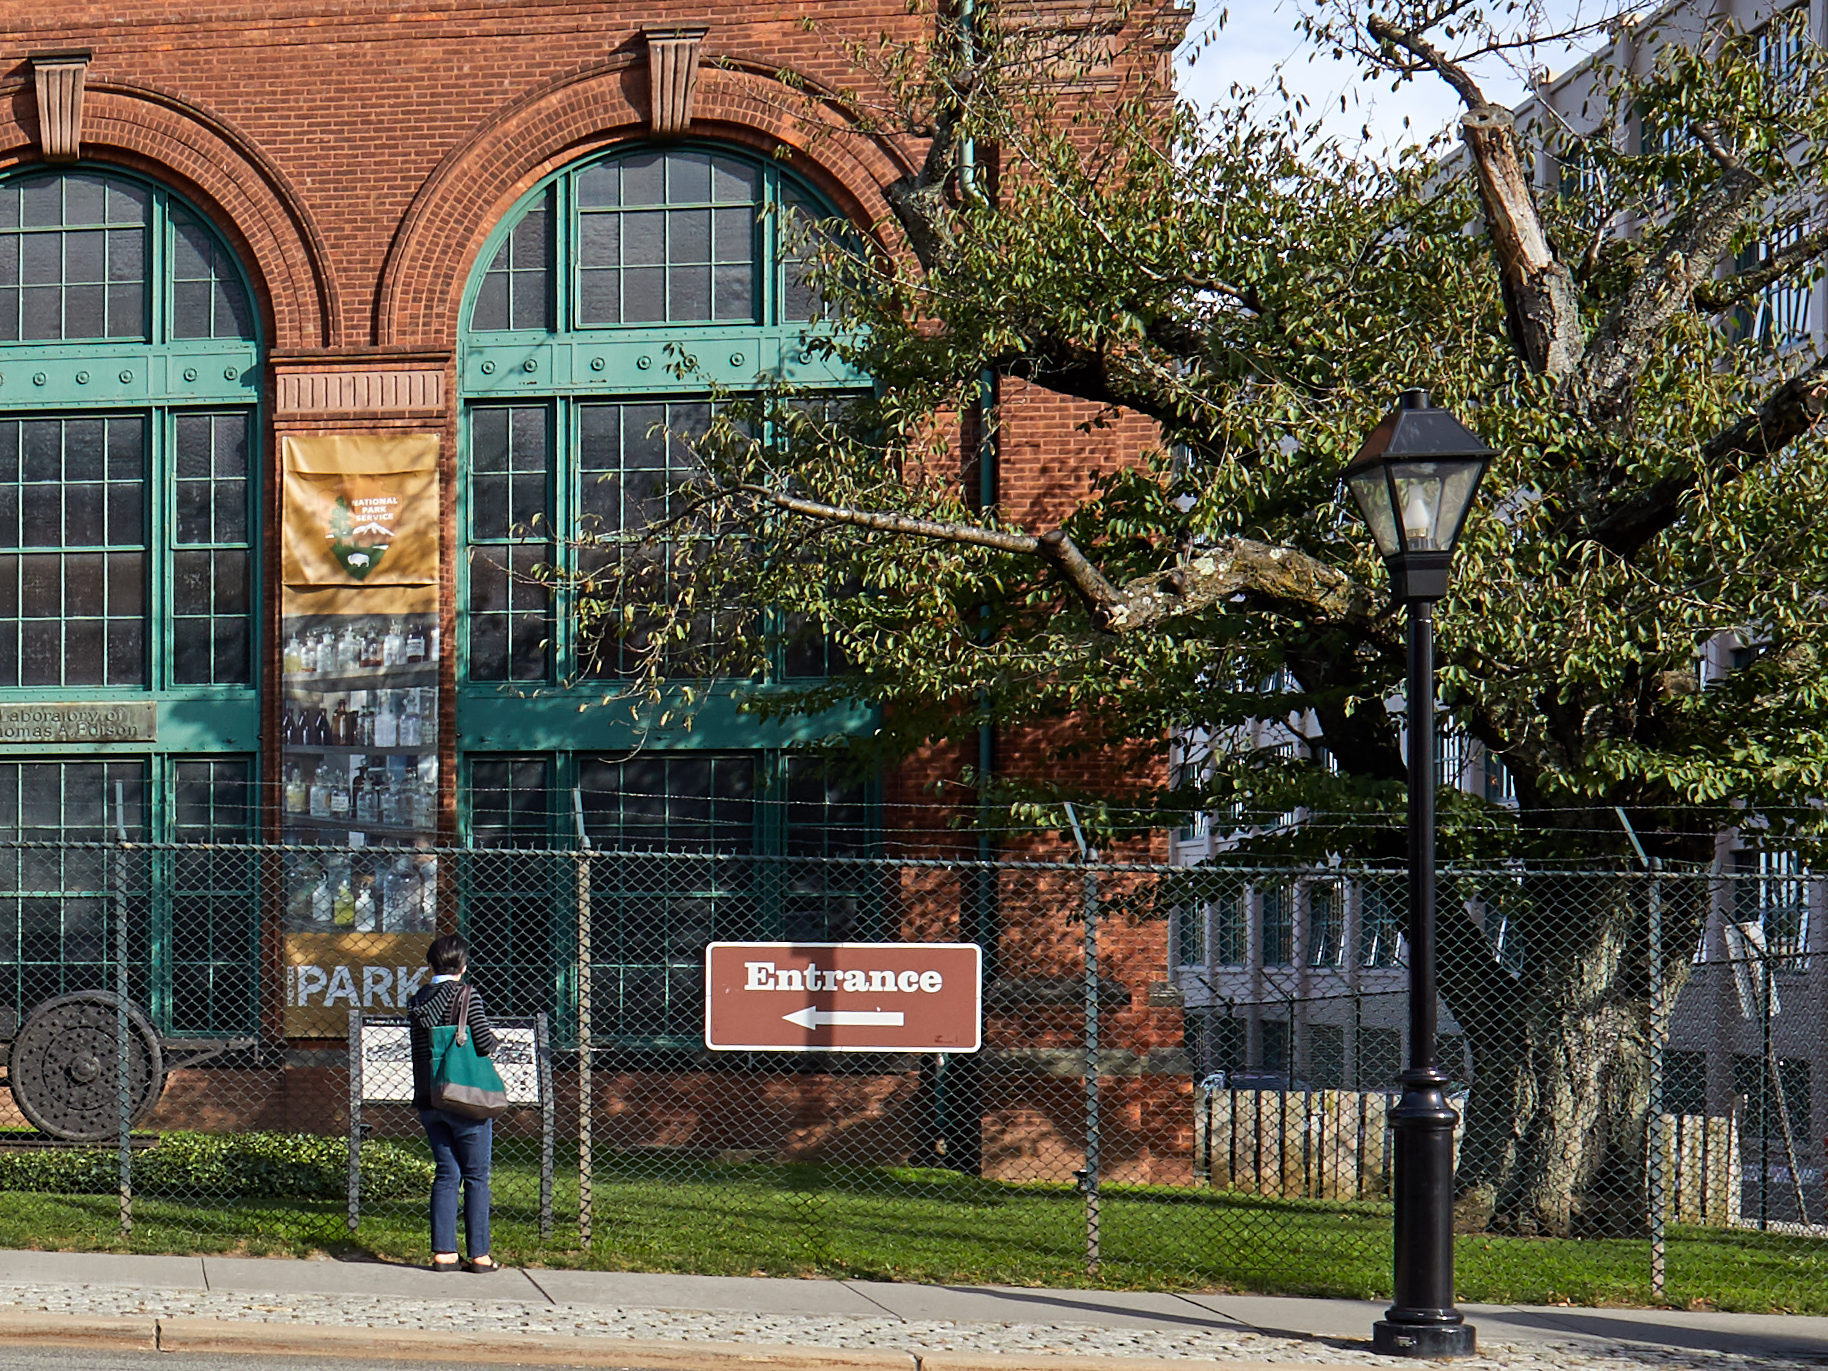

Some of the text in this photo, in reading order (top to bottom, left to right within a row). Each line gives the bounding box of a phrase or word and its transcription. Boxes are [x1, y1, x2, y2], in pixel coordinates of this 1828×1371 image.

[351, 497, 398, 506] NATIONAL
[362, 506, 387, 514] PARK
[356, 513, 394, 521] SERVICE
[105, 708, 123, 721] of
[76, 722, 138, 737] Edison
[744, 961, 942, 993] Entrance
[297, 965, 429, 1007] PARK
